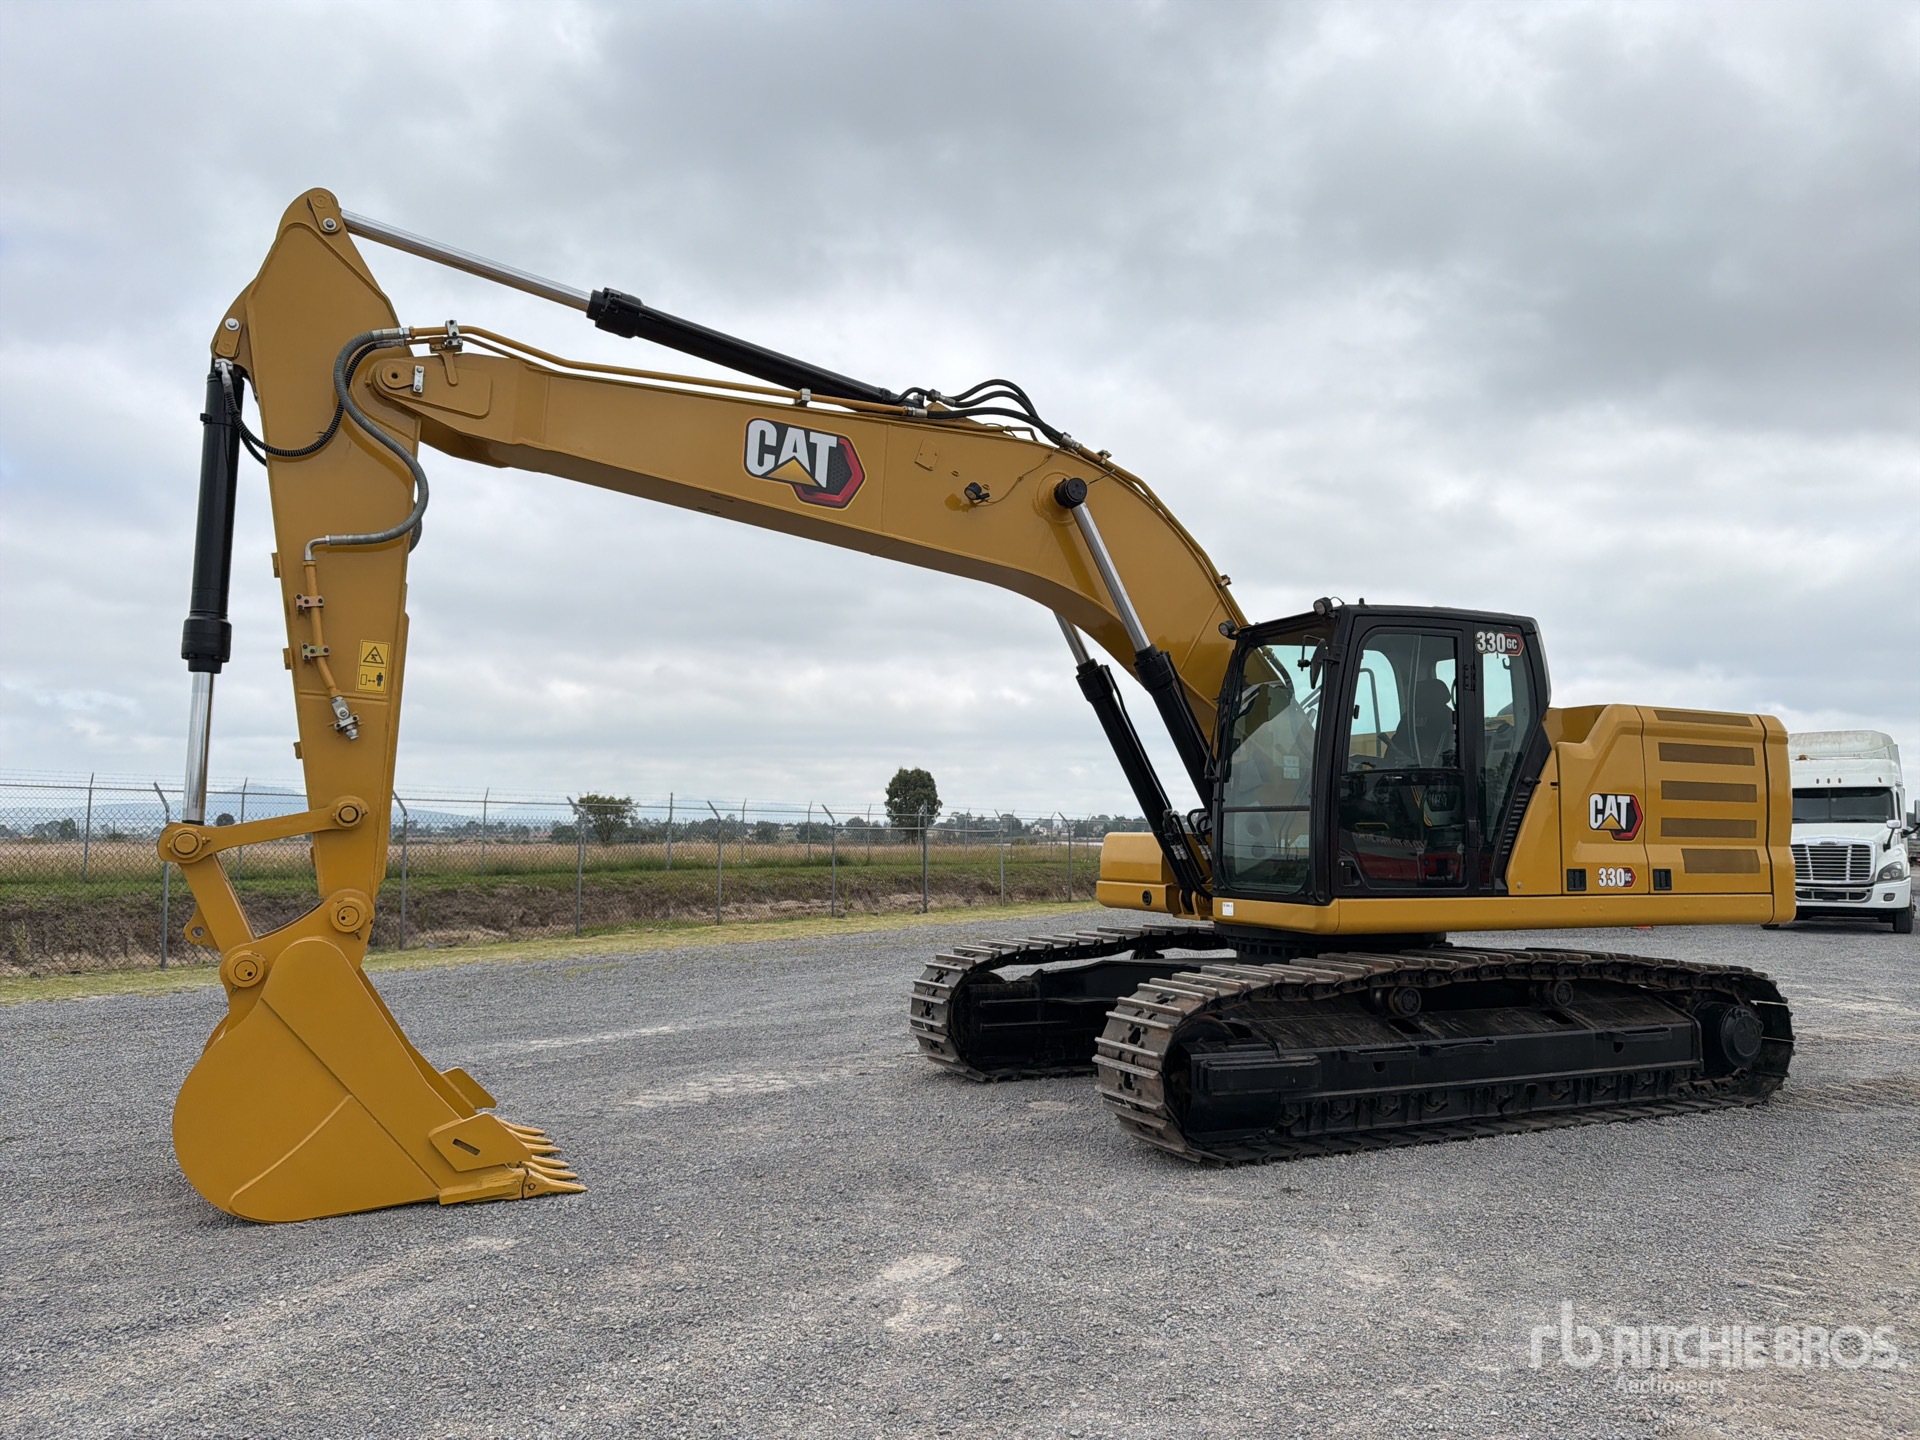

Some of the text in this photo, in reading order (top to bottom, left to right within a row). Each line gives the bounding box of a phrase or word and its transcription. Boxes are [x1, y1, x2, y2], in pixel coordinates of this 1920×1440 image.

[746, 419, 838, 488] CAT
[1476, 631, 1518, 653] 330 GC
[1589, 793, 1631, 829] CAT
[1598, 867, 1625, 887] 330
